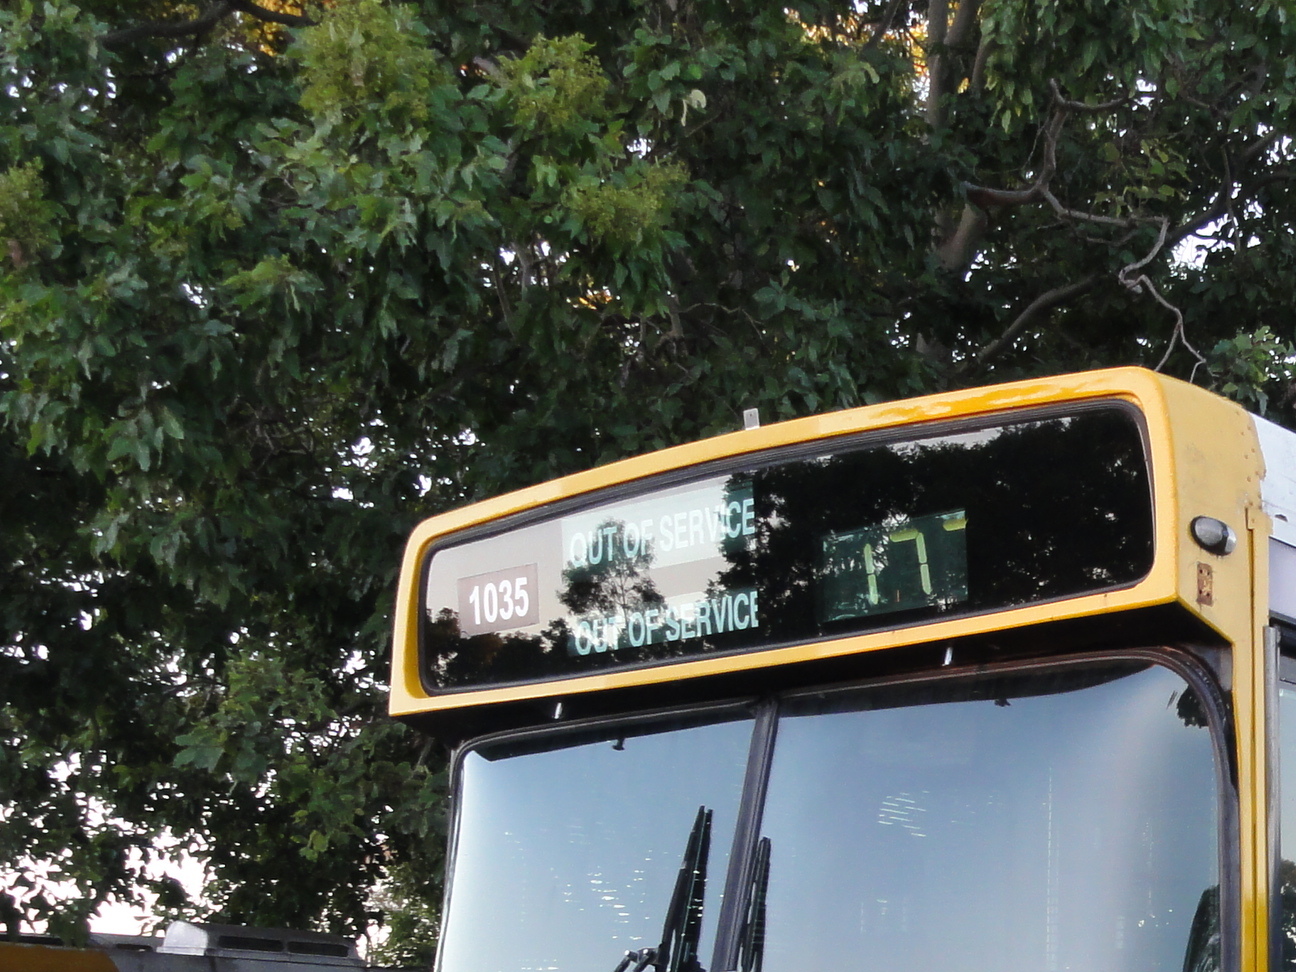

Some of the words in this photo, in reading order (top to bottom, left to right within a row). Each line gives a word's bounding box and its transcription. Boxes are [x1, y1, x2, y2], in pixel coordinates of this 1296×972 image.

[569, 526, 618, 568] OUT
[623, 519, 654, 559] OF
[659, 497, 756, 553] SERVICE
[469, 576, 530, 627] 1035
[574, 615, 623, 656] OUT
[628, 608, 659, 648] OF
[665, 590, 759, 642] SERVICE
